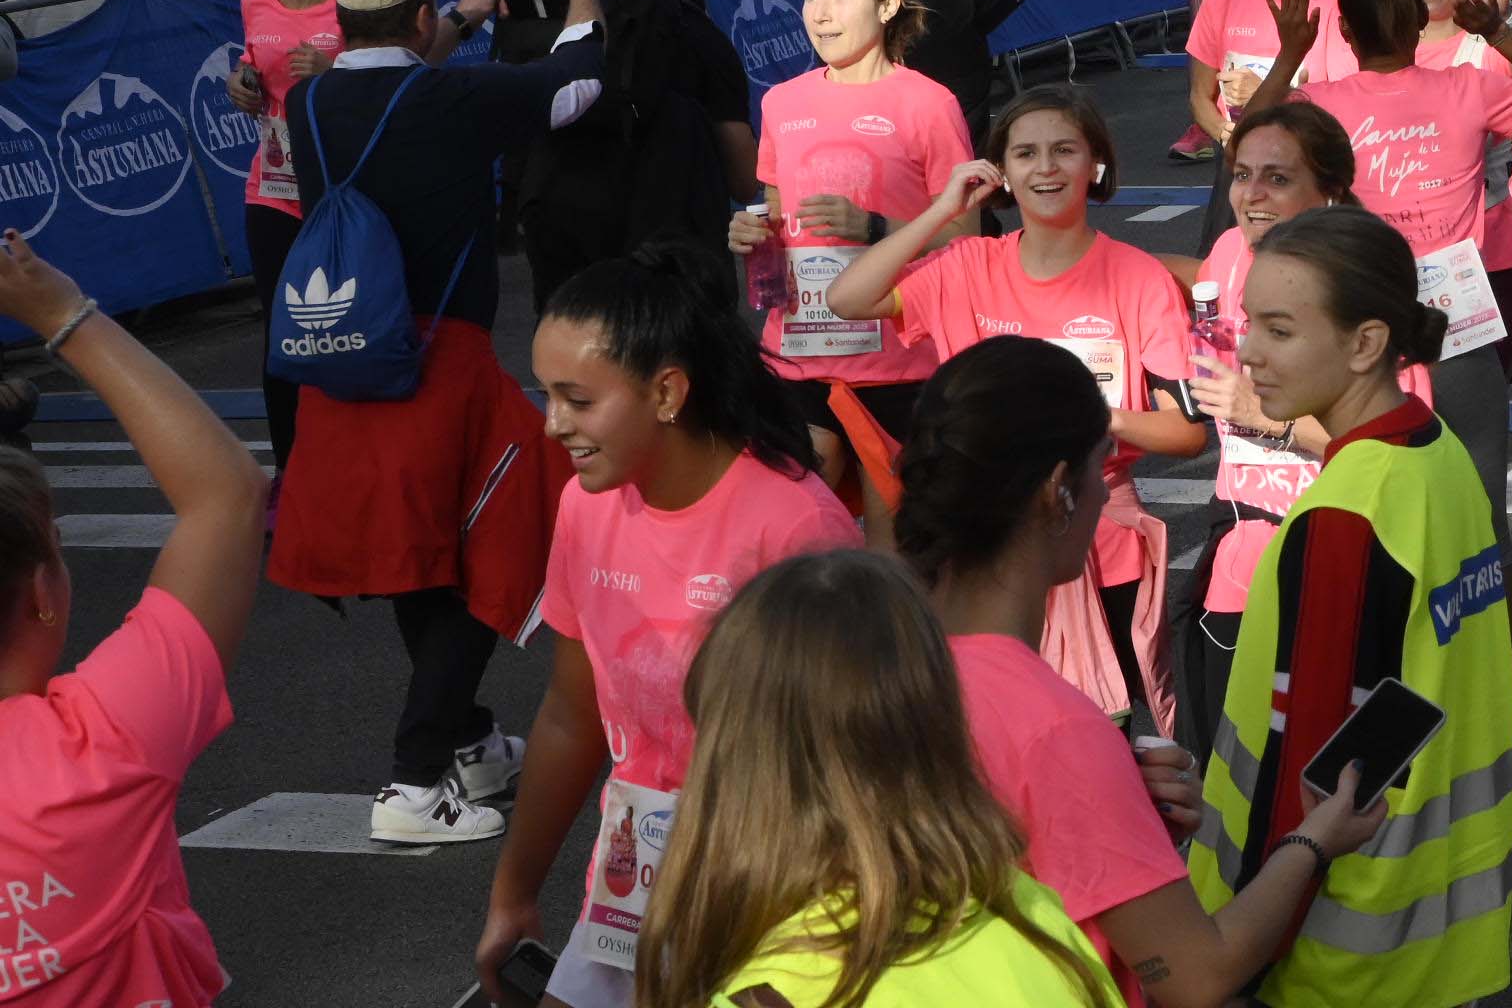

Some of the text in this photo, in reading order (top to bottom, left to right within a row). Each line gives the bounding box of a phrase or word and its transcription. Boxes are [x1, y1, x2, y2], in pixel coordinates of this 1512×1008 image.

[780, 117, 817, 134] OYSHO
[1350, 115, 1441, 152] Carrera
[1367, 145, 1430, 198] Mujer
[975, 312, 1023, 335] OYSHO
[280, 330, 367, 357] adidas
[1087, 356, 1113, 364] SUMA
[590, 567, 641, 593] OYSHO
[605, 912, 642, 930] CARRERA
